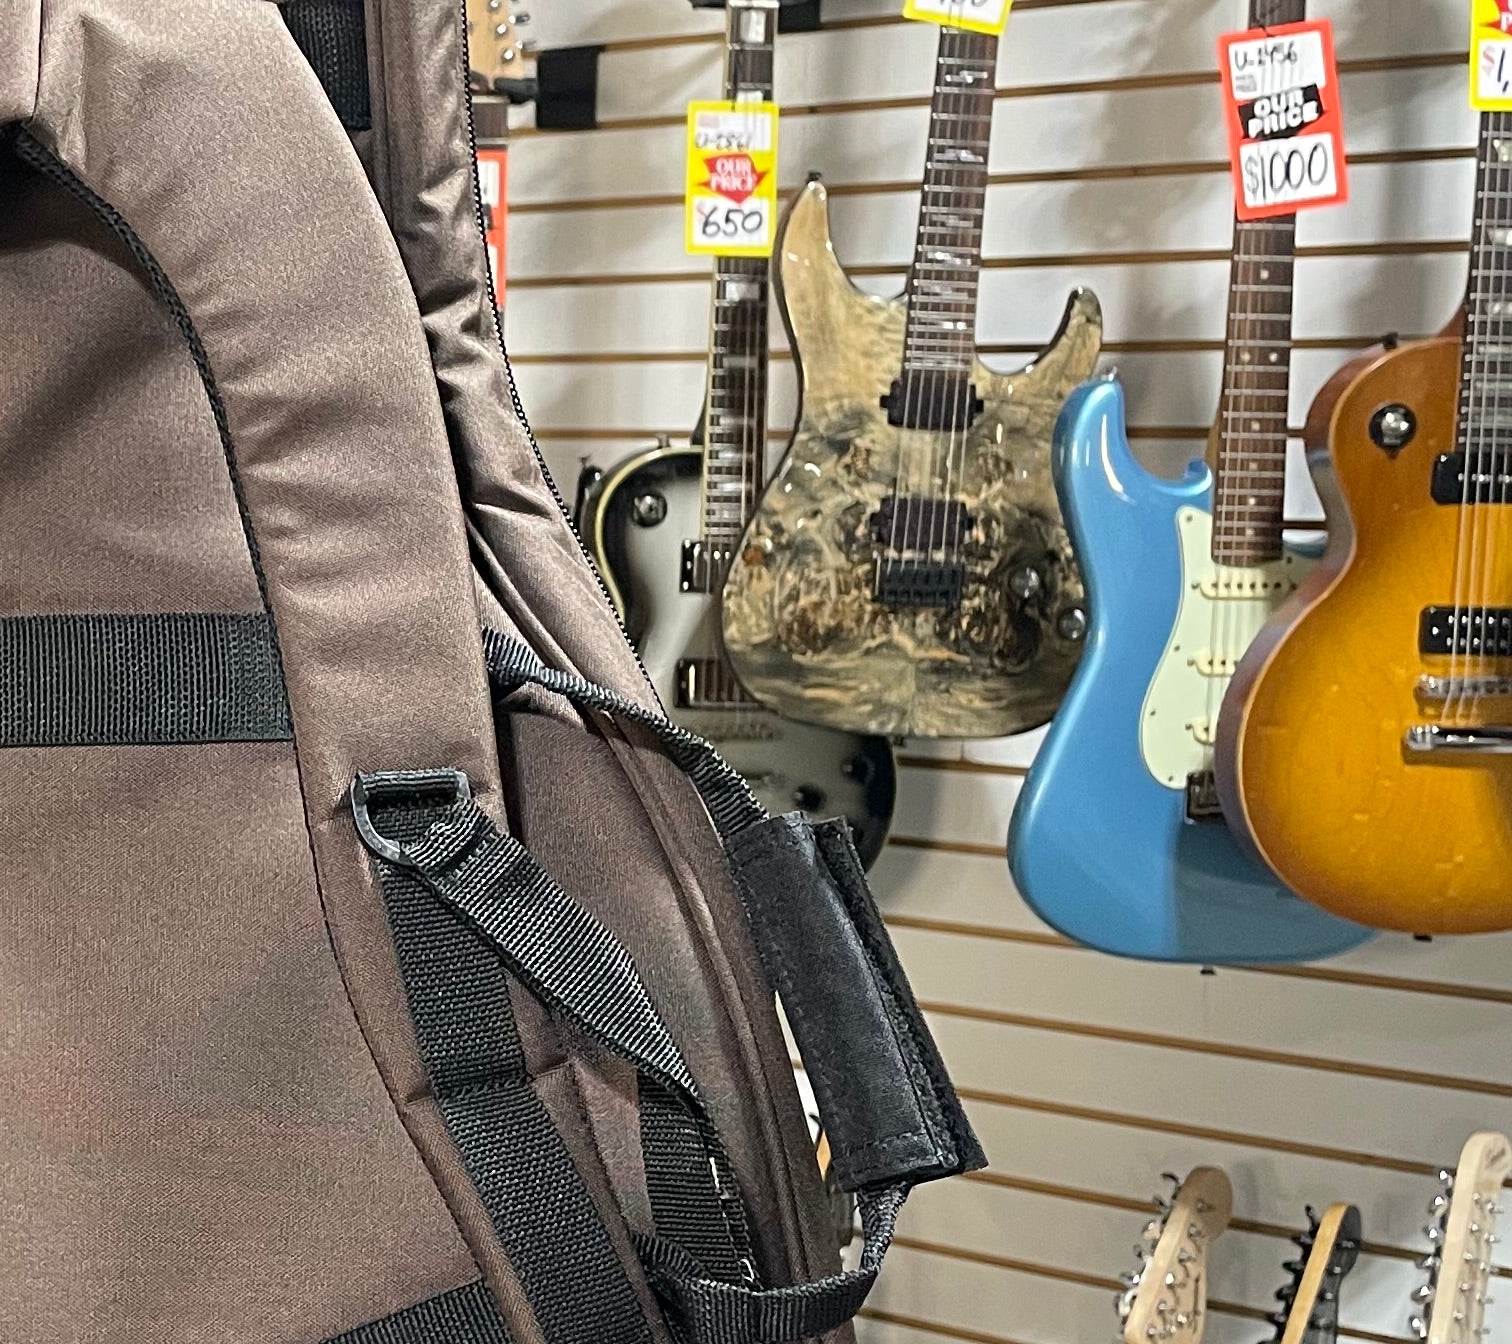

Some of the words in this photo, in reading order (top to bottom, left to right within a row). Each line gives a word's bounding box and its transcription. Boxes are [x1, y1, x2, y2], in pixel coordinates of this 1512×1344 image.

[1253, 87, 1305, 118] OUR
[1248, 100, 1319, 139] PRICE
[710, 172, 758, 193] PRICE
[715, 157, 753, 177] OUR
[1244, 141, 1329, 201] $1000
